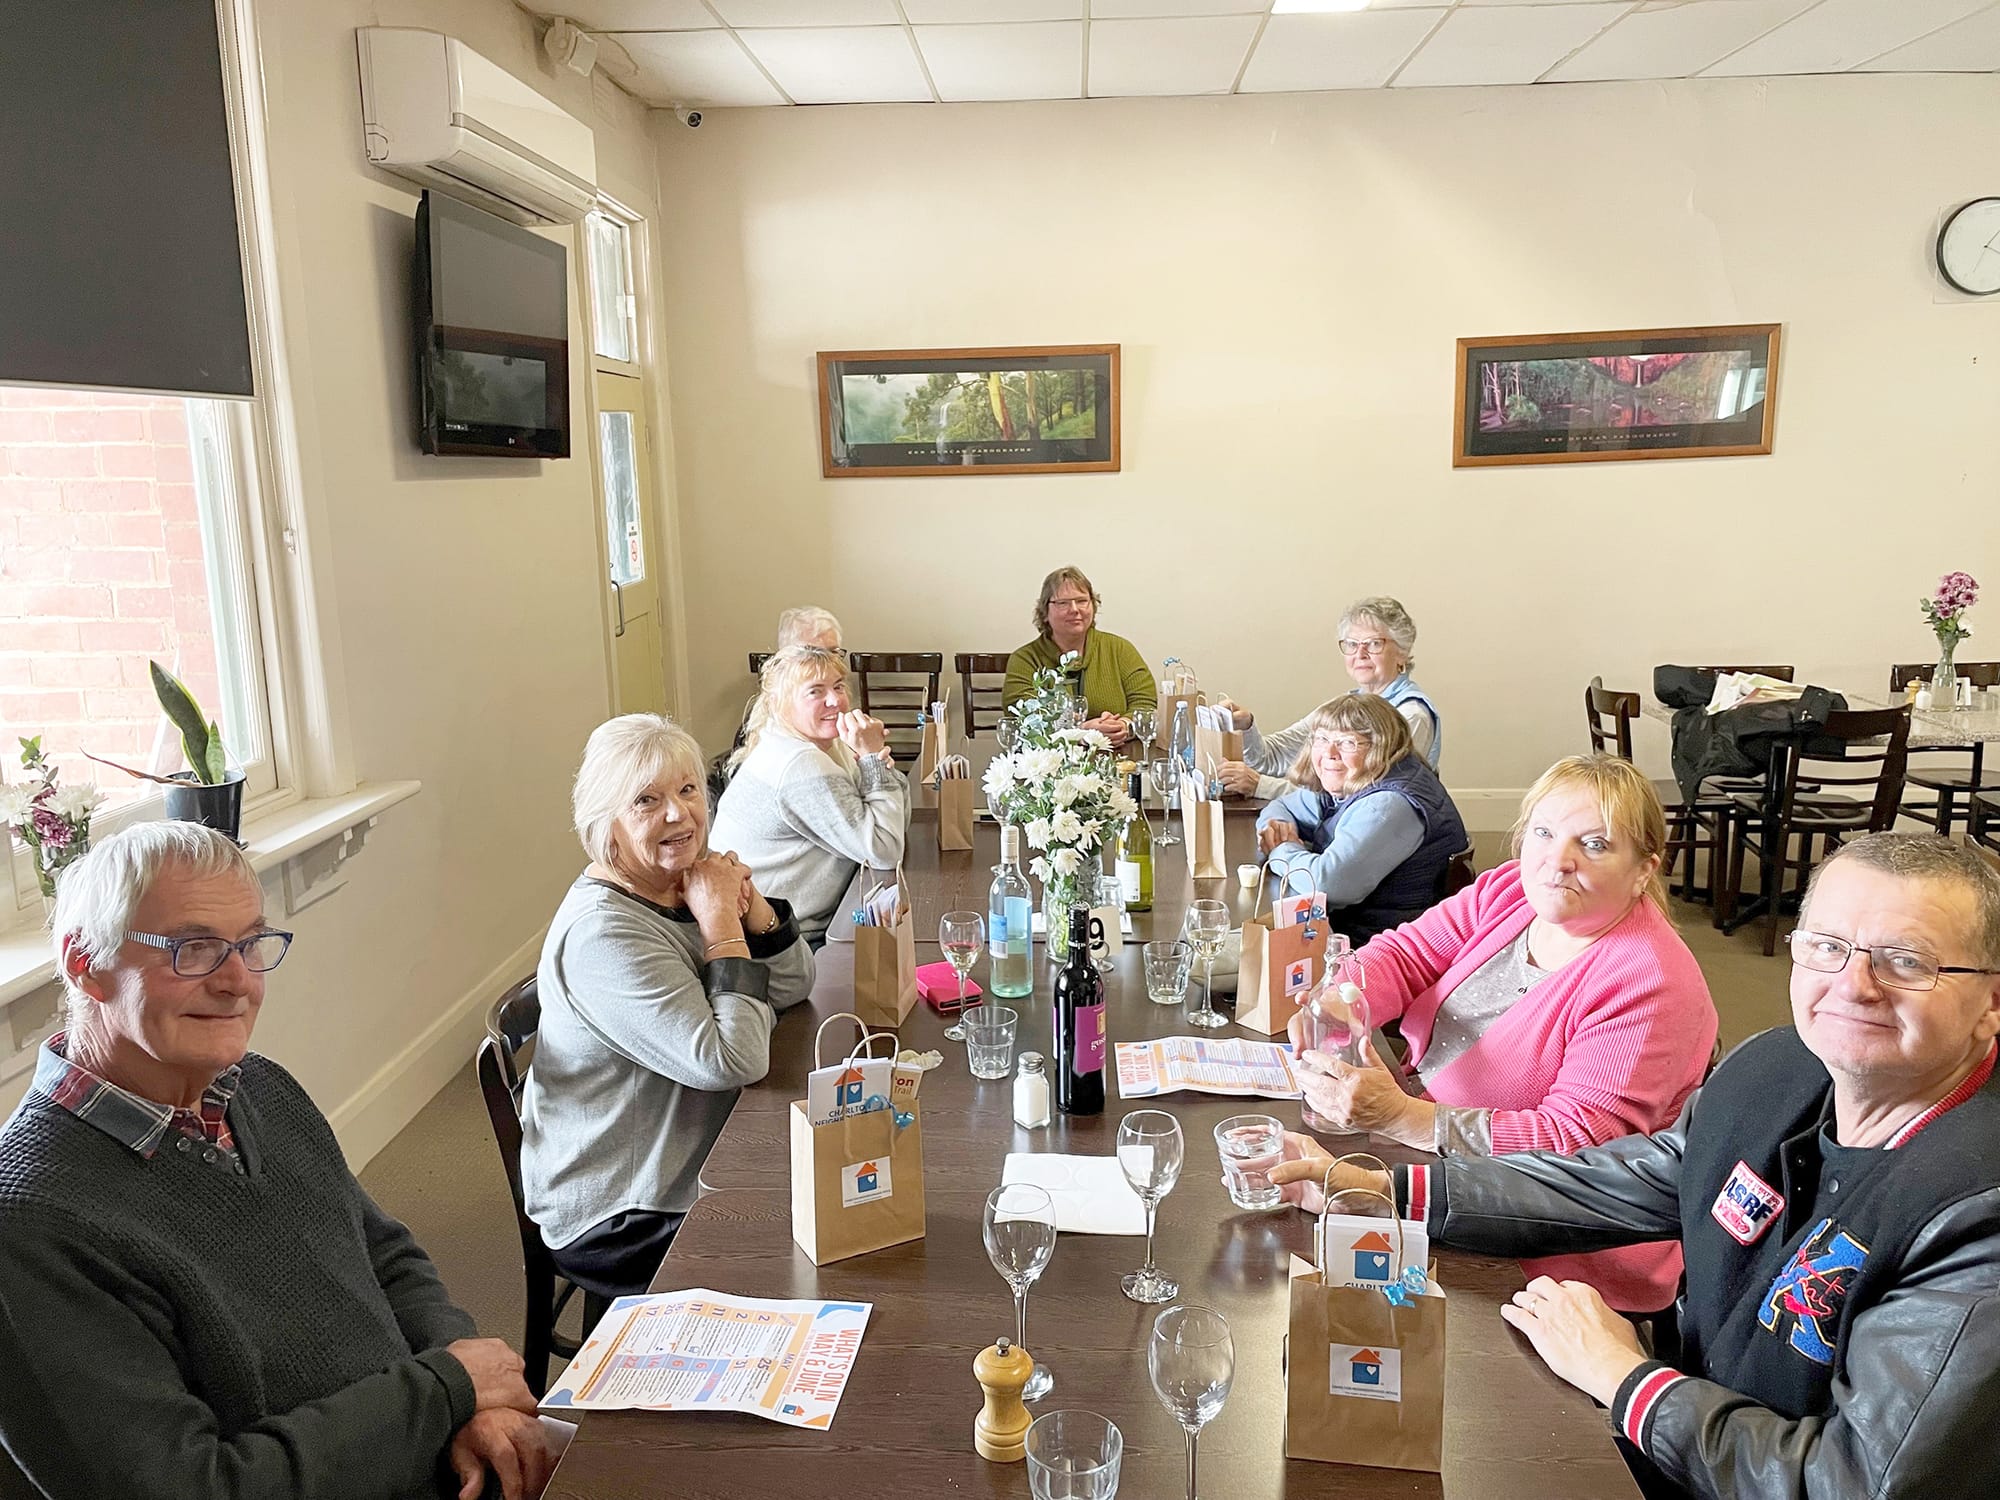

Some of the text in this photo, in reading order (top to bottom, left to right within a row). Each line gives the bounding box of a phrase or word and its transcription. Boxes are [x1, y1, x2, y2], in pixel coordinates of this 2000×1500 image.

[1956, 683, 1962, 701] 7
[1088, 917, 1104, 951] 9
[689, 1303, 703, 1311] 11
[712, 1307, 726, 1316] 11
[810, 1333, 836, 1357] MAY
[757, 1357, 772, 1370] 25
[780, 1352, 795, 1370] MAY
[814, 1329, 861, 1401] WHAT'S ON IN
[793, 1368, 823, 1395] JUNE
